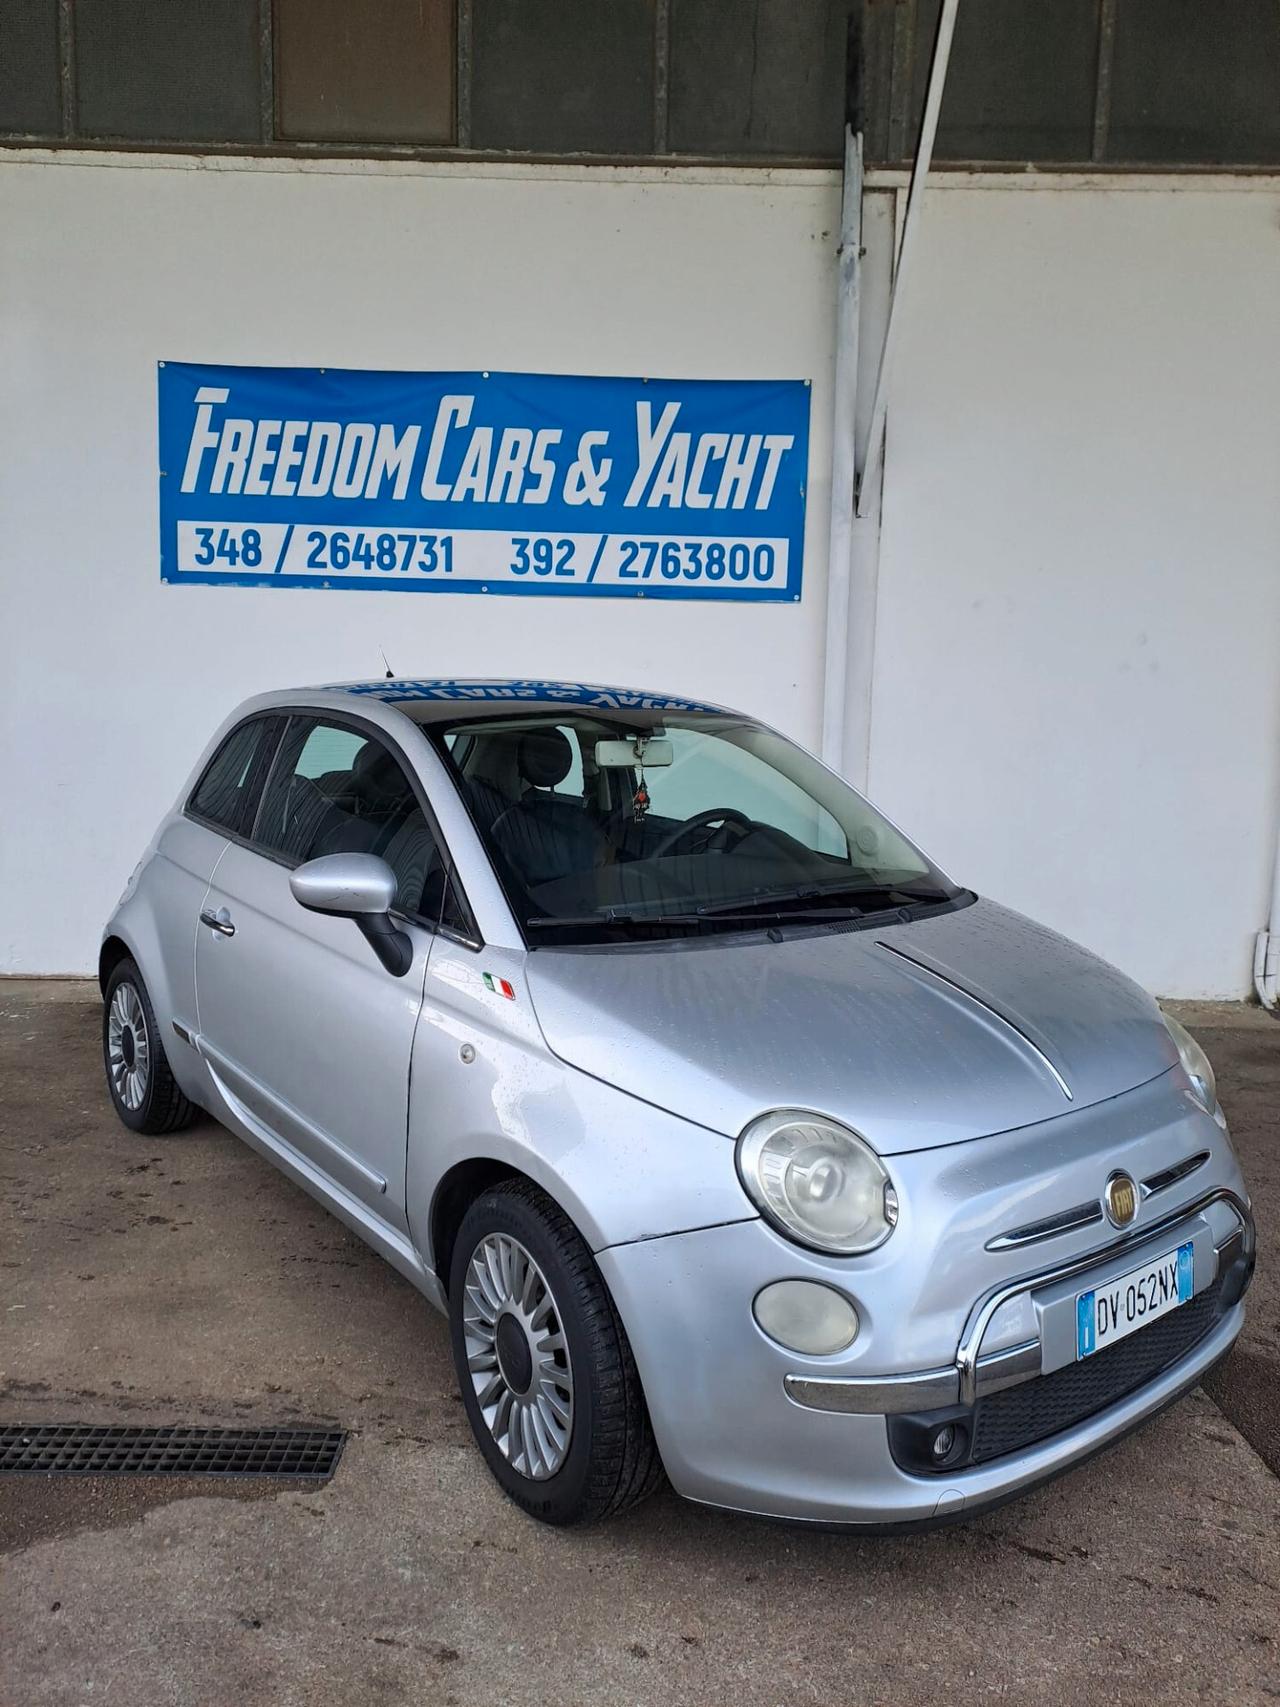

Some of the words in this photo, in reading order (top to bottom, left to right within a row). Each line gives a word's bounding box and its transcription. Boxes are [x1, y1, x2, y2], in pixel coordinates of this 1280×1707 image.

[180, 387, 422, 500] FREEDOM
[420, 394, 563, 504] CARS
[562, 430, 613, 507] &
[623, 400, 795, 511] YACHT
[194, 528, 262, 567] 348
[306, 530, 454, 573] 2648731
[510, 537, 576, 577] 392
[618, 540, 775, 582] 2763800
[1114, 1187, 1133, 1218] FIAT
